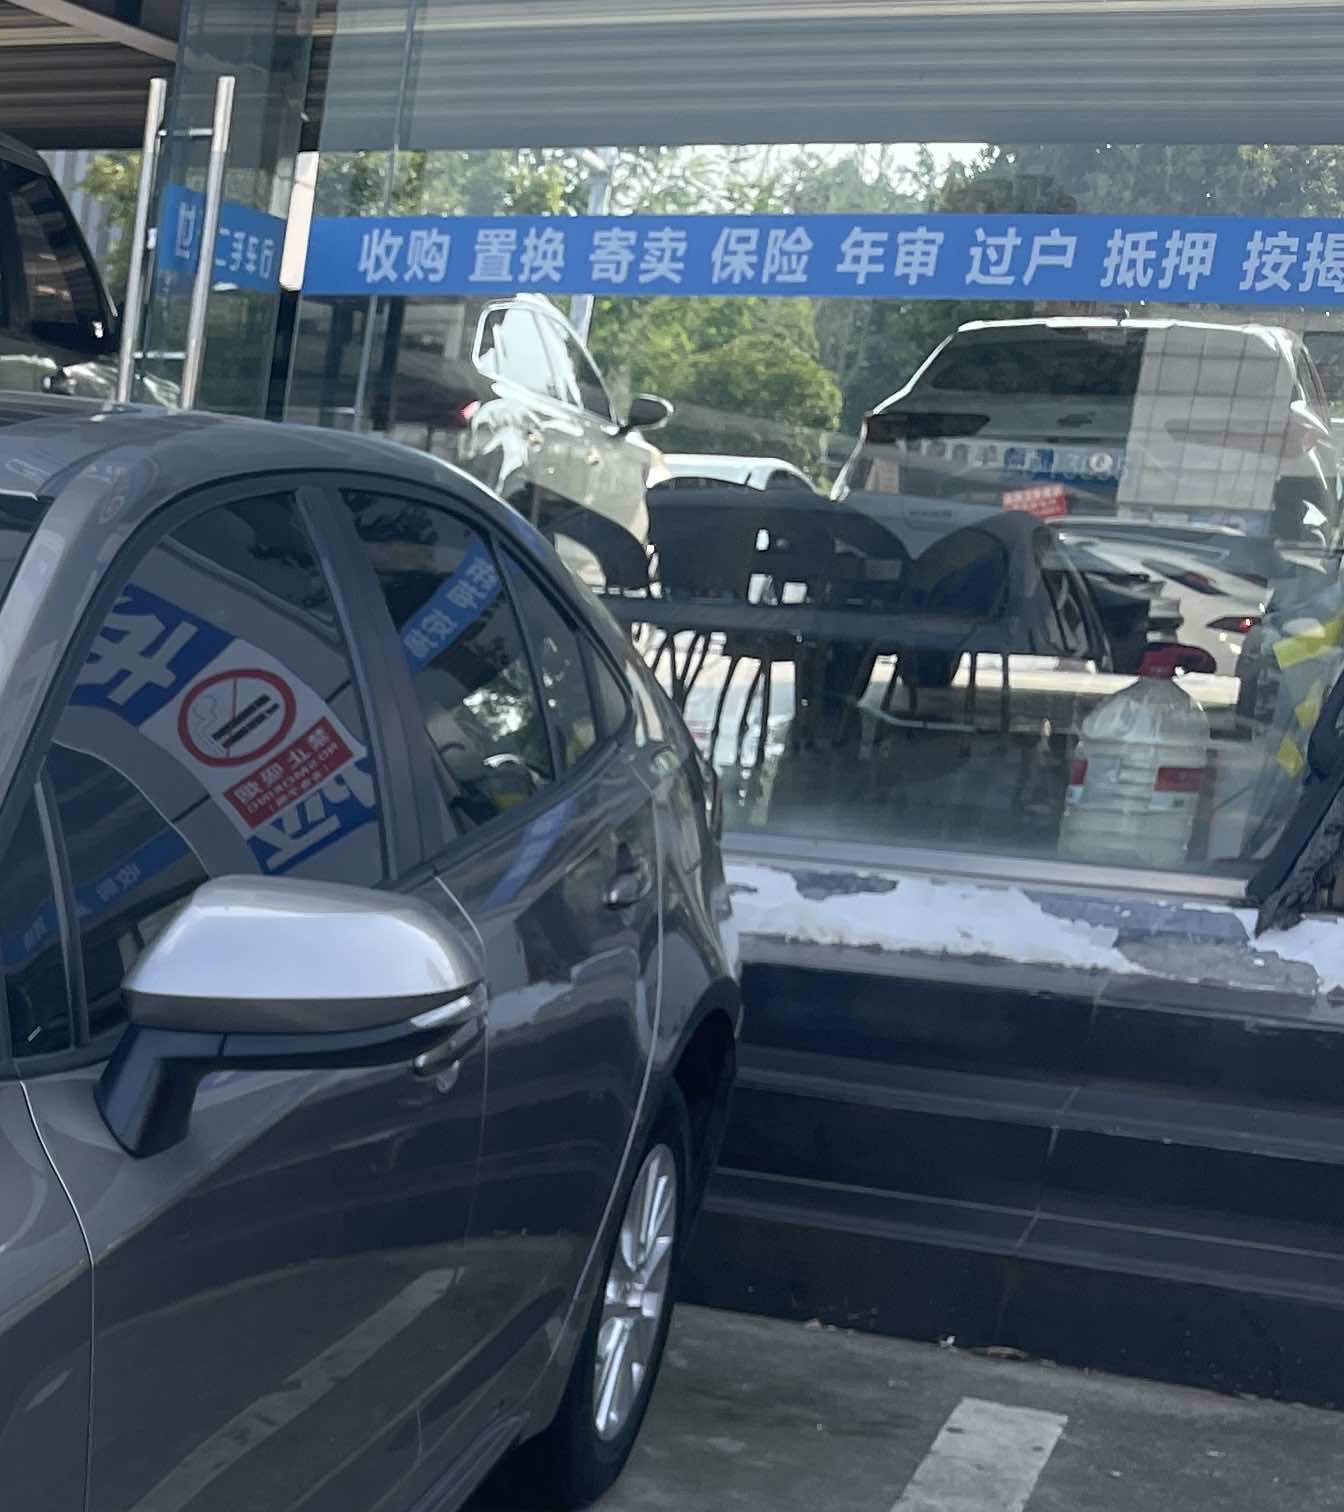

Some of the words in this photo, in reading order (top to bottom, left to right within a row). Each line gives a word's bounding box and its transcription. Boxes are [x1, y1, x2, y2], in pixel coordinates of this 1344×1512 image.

[358, 226, 451, 284] 收购
[468, 226, 566, 284] 置换
[588, 226, 688, 284] 寄卖
[711, 226, 814, 284] 保险
[836, 226, 945, 286] 年审
[965, 227, 1078, 287] 过户
[1100, 228, 1218, 290] 抵押
[1239, 230, 1344, 293] 按揭
